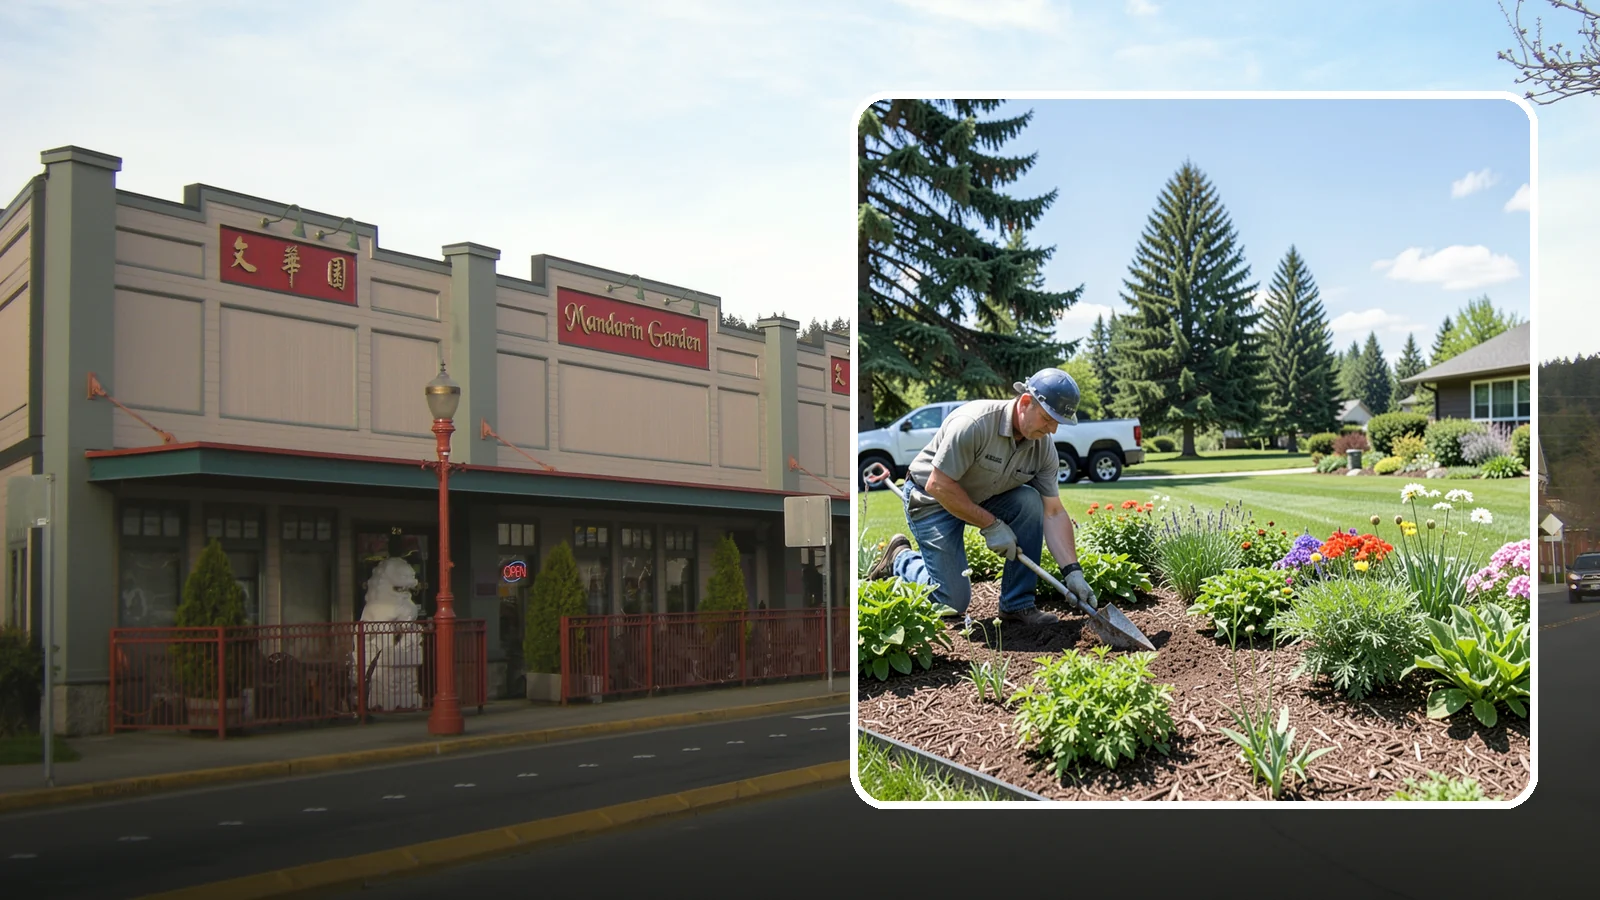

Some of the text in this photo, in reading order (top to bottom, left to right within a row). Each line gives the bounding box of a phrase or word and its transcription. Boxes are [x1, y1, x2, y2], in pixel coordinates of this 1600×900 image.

[230, 235, 346, 291] 文華園
[564, 302, 702, 352] Mandarin Garden
[503, 565, 527, 578] OPEN
